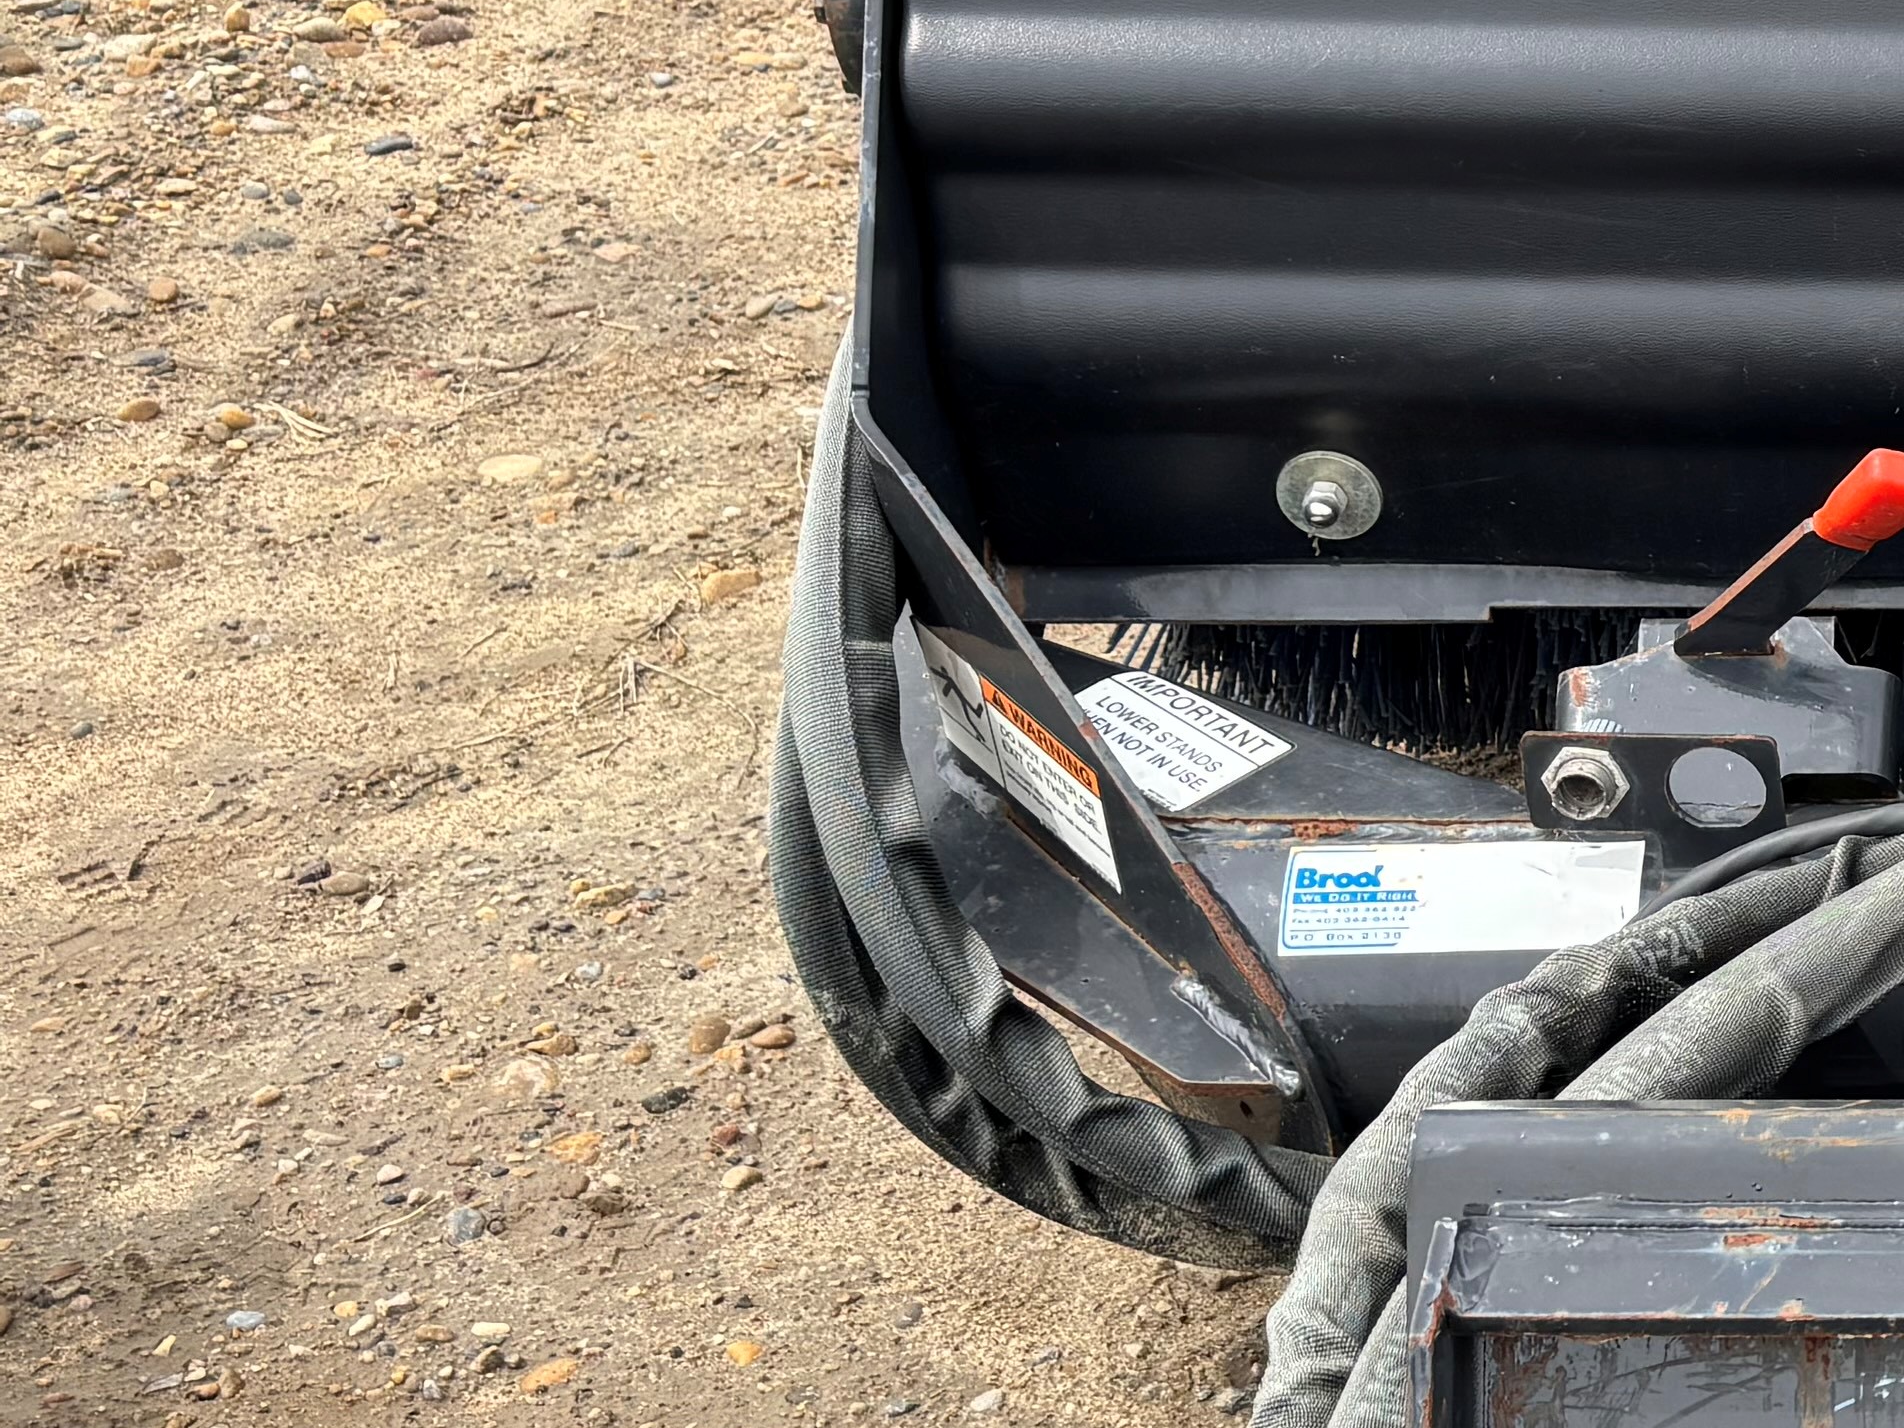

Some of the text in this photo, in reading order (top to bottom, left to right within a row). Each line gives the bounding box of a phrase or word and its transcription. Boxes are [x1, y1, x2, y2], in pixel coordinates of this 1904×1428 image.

[1008, 703, 1093, 789] WARNING
[1095, 695, 1224, 772] LOWER STANDS
[1111, 731, 1155, 757] NOT
[1146, 752, 1174, 770] IN
[1126, 675, 1275, 754] IMPORTANT
